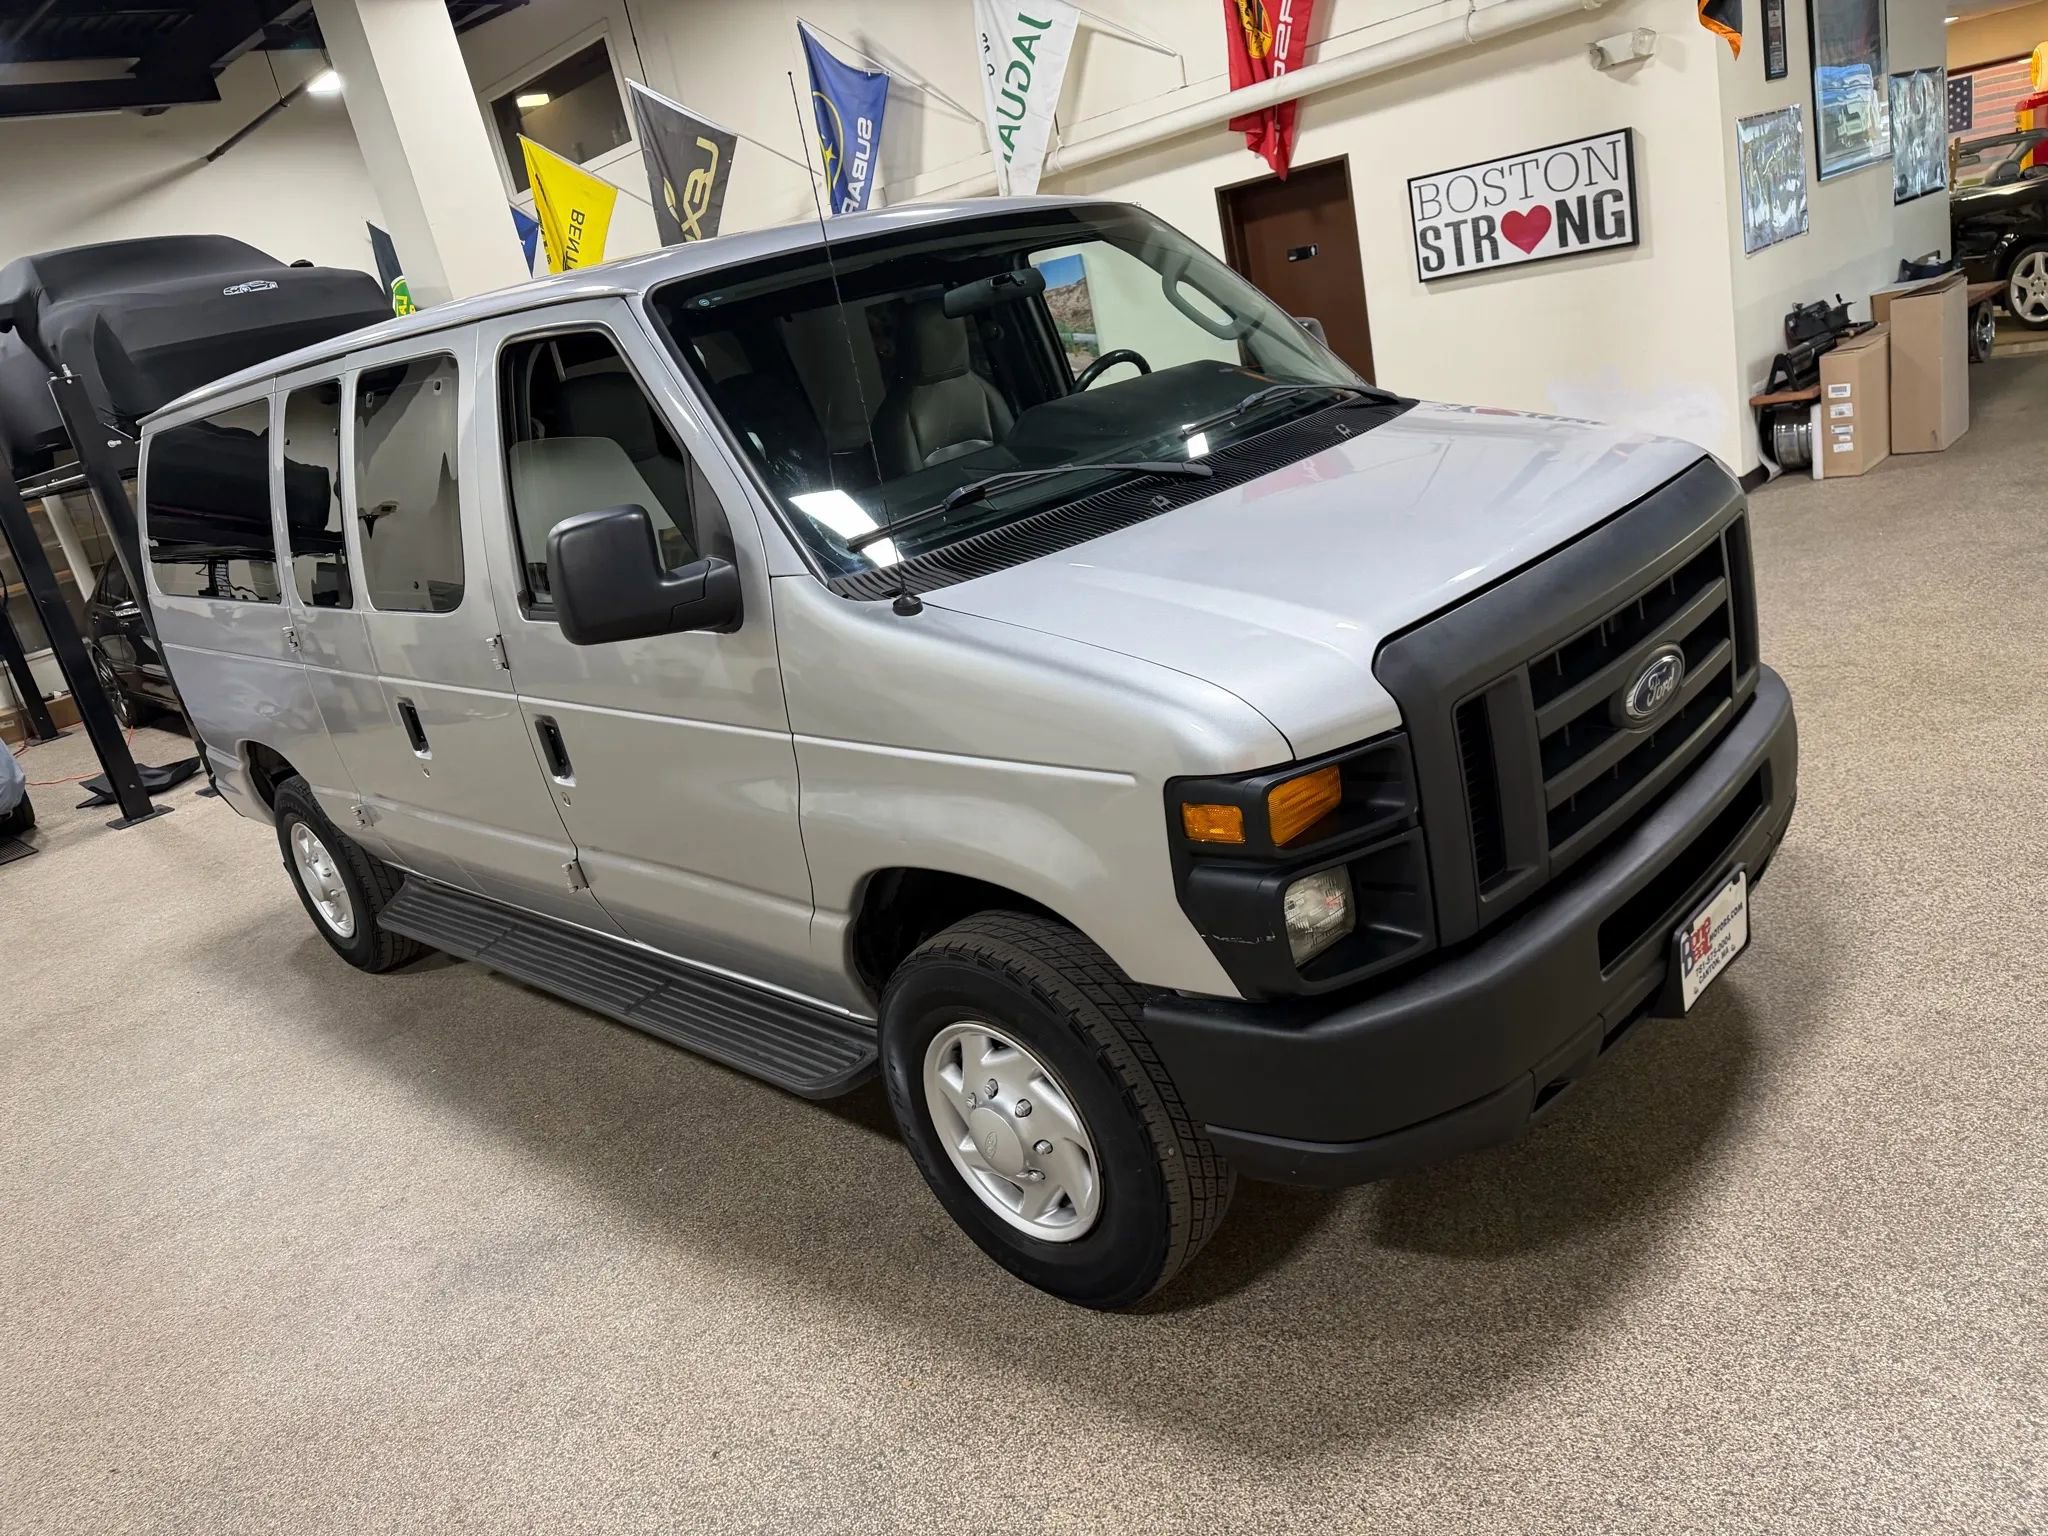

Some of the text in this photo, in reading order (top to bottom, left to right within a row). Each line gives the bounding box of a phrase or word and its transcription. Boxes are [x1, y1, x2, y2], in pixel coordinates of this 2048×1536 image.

[1414, 139, 1621, 222] BOSTON
[1419, 188, 1627, 273] STRNG
[1646, 665, 1675, 708] Ford
